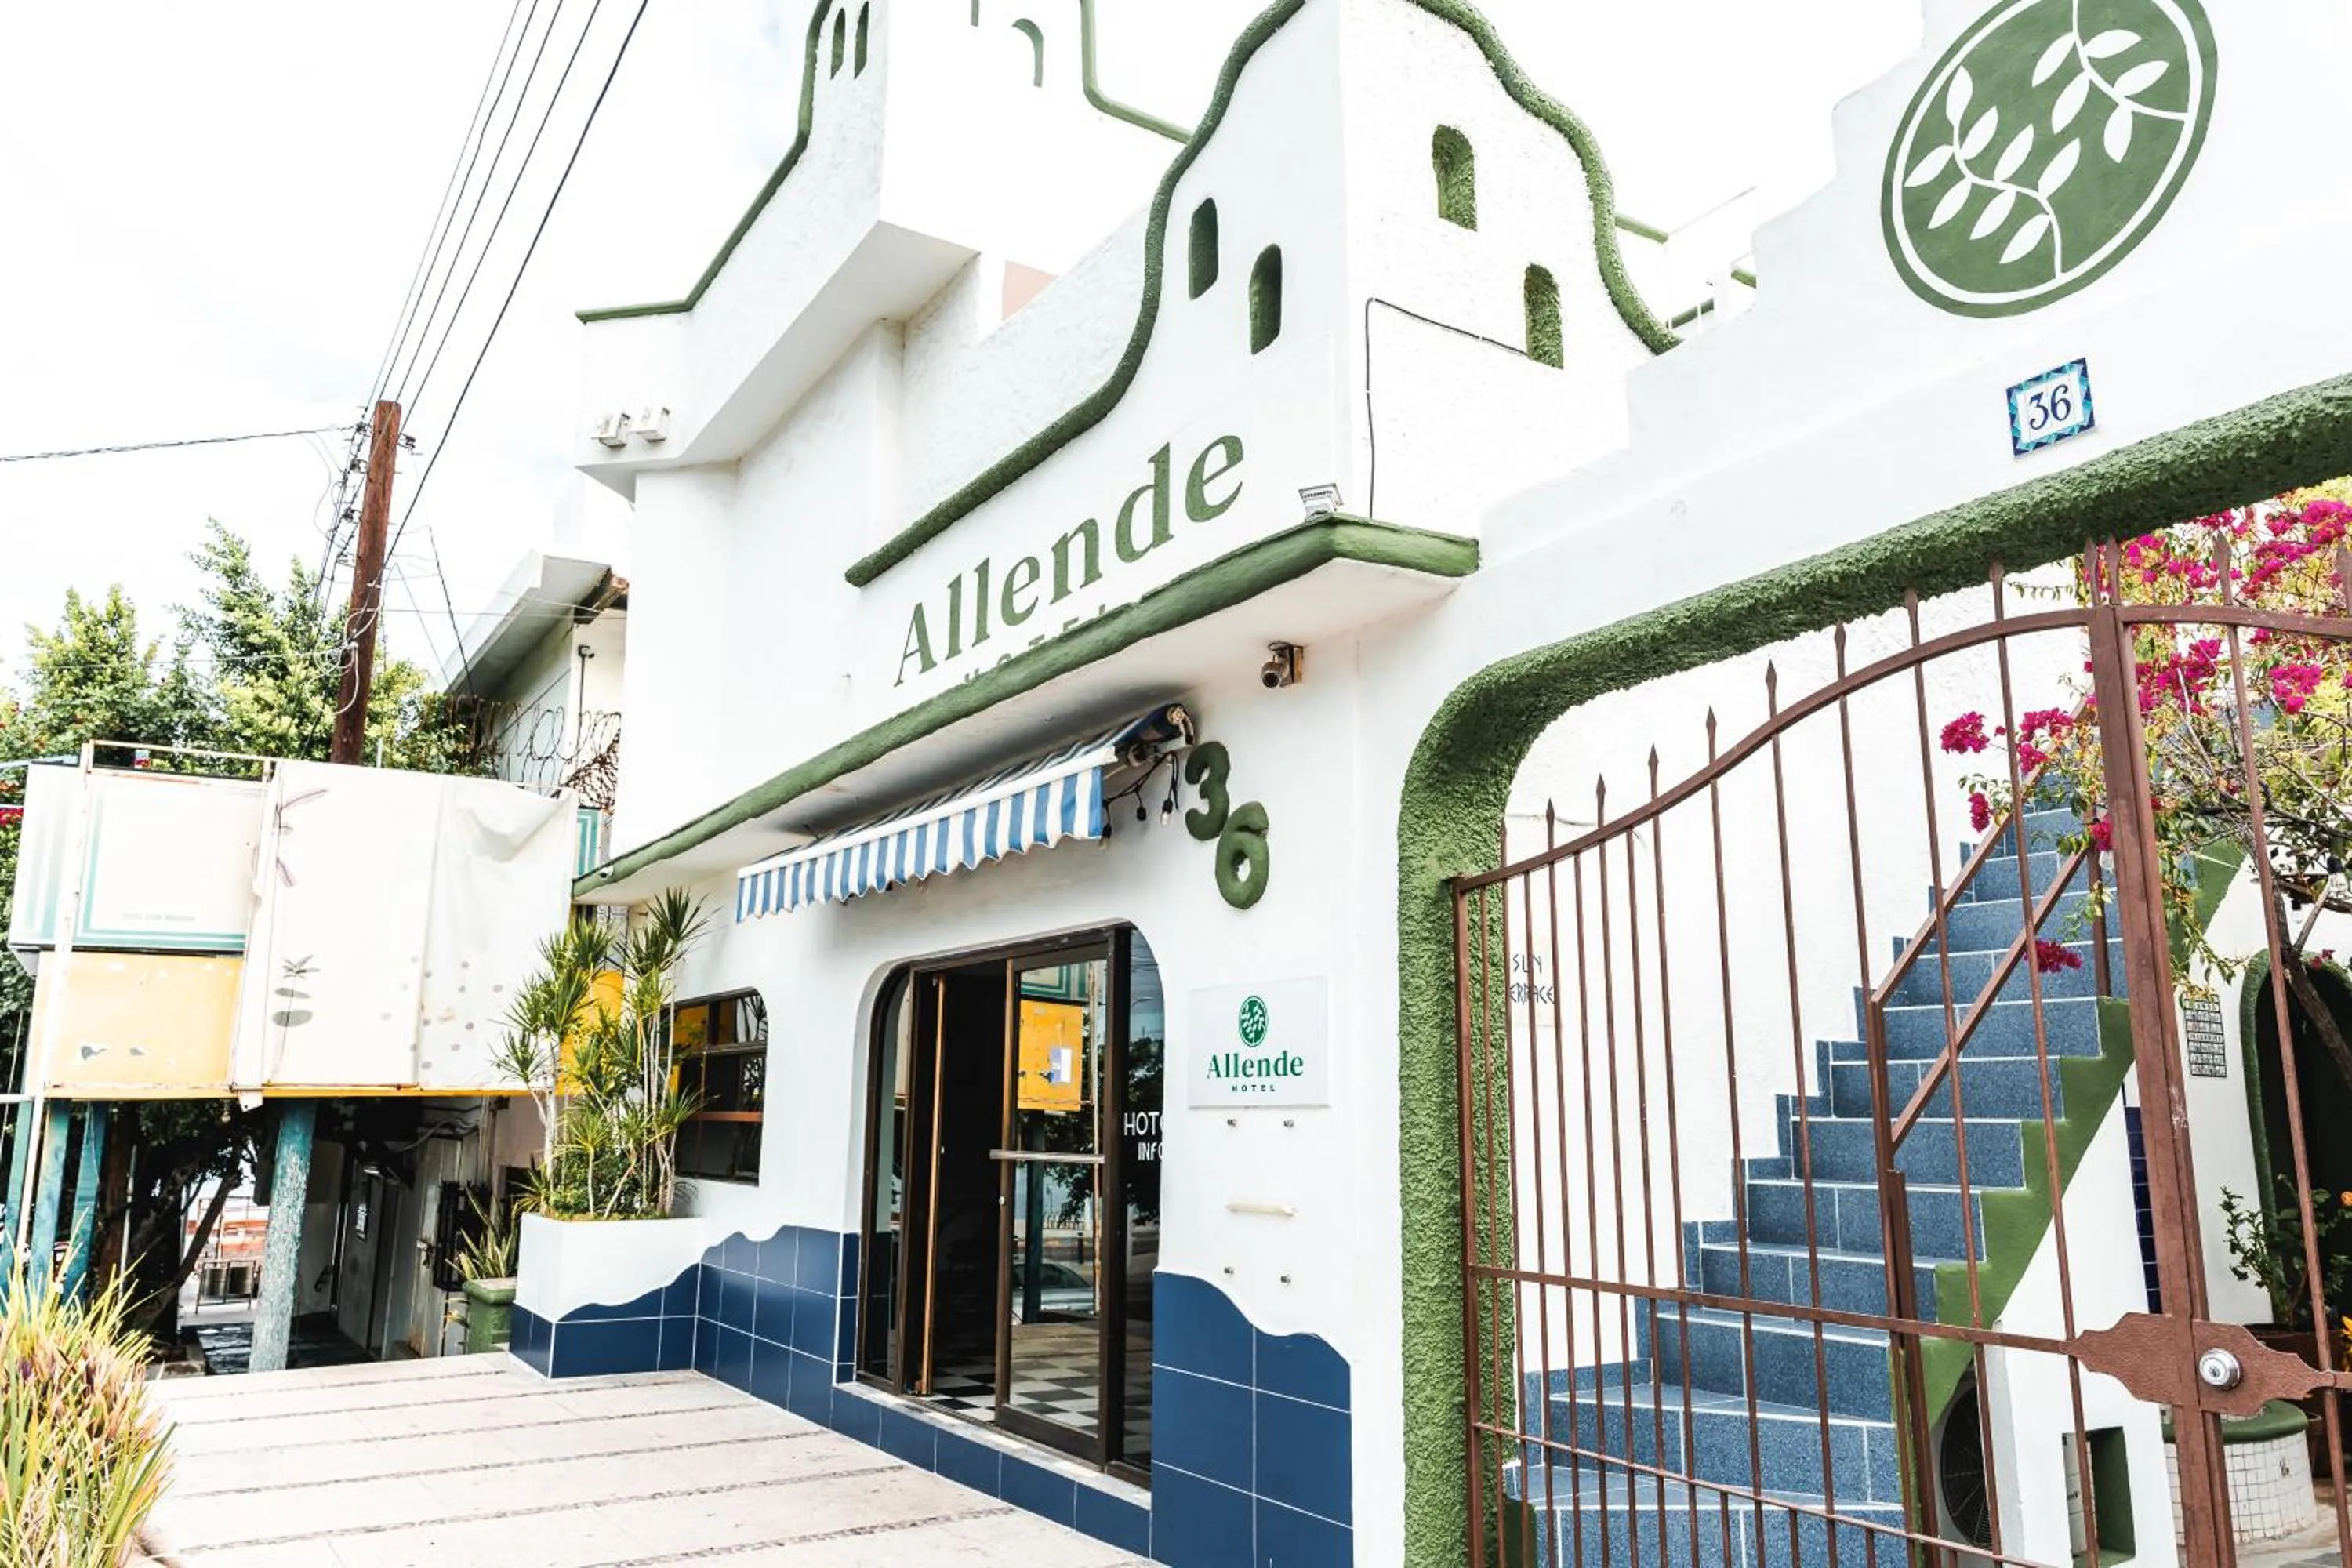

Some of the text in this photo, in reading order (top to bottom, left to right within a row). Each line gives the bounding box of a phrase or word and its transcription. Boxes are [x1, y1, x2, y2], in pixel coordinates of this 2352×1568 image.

[2029, 383, 2071, 430] 36
[893, 434, 1245, 688] Allende
[1185, 741, 1269, 910] 36
[1509, 982, 1555, 1004] ERRACE
[1207, 1050, 1304, 1079] Allende
